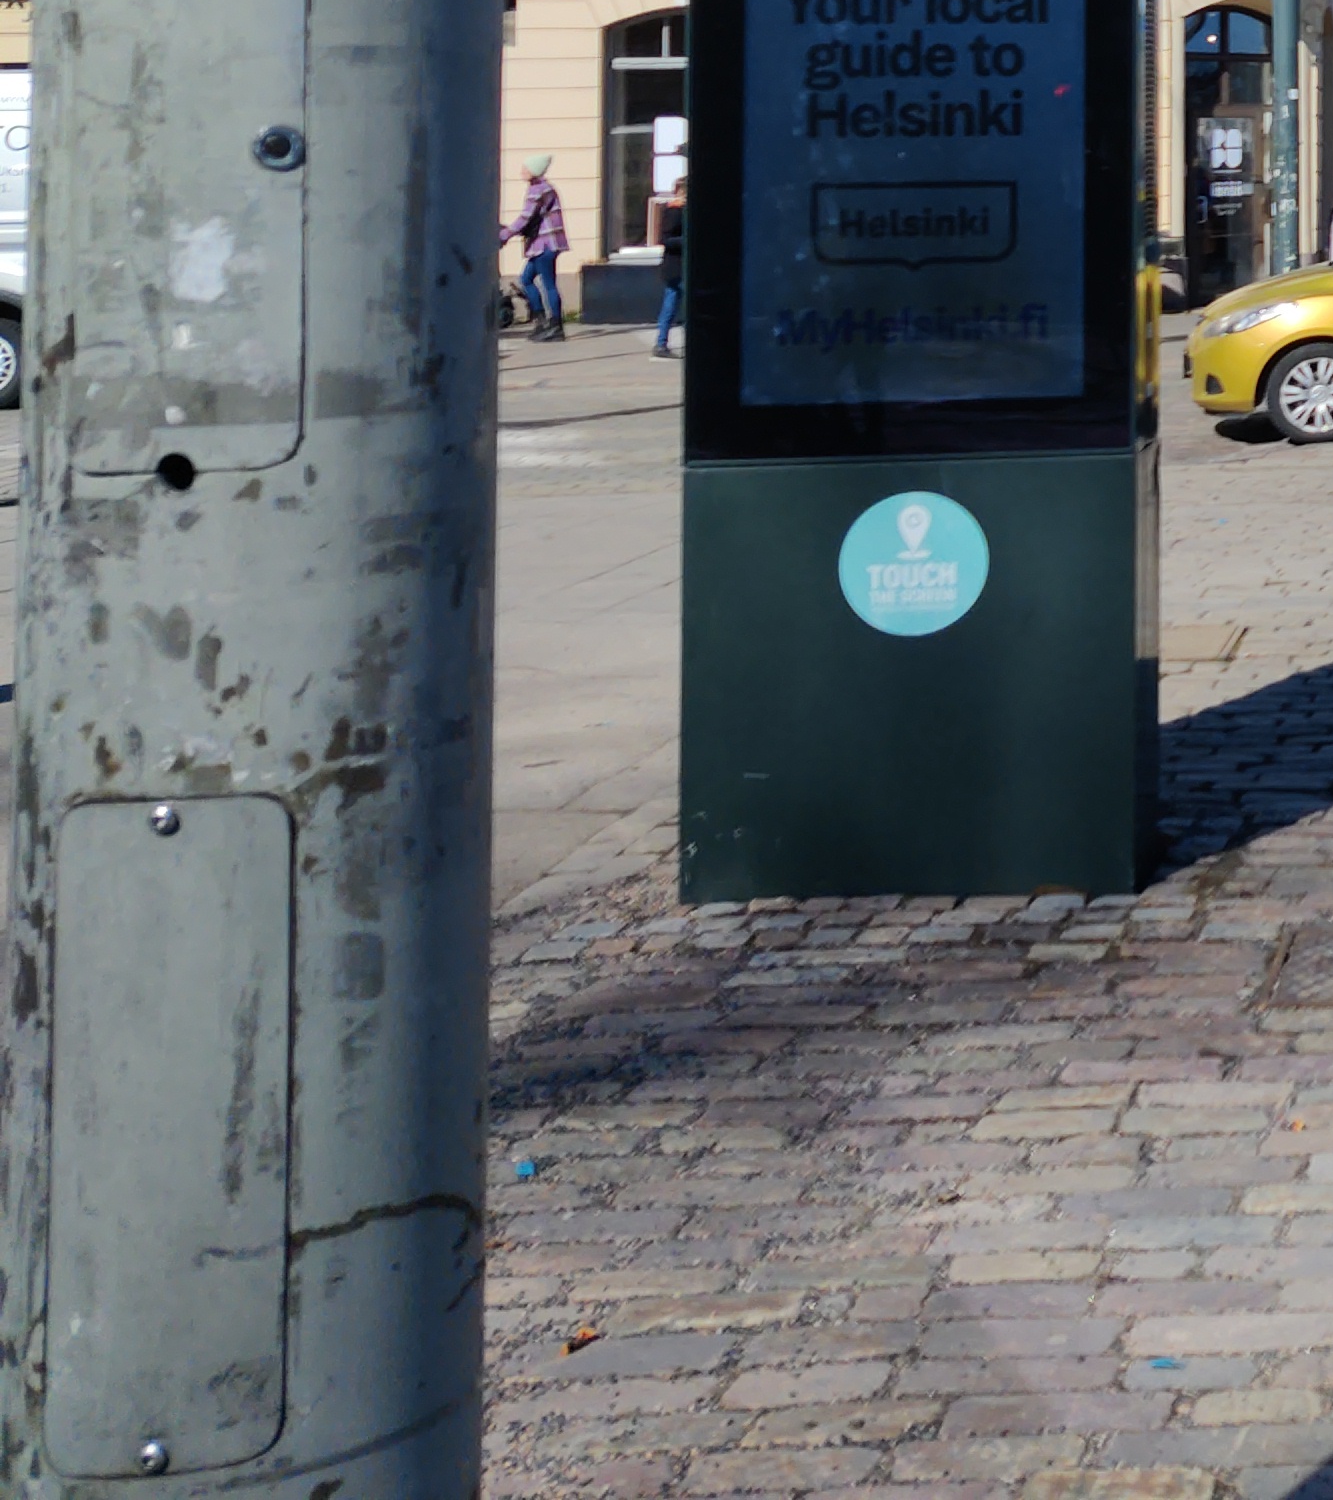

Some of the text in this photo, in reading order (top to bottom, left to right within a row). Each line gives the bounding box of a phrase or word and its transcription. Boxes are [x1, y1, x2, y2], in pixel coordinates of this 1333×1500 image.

[804, 32, 1023, 90] guide to
[806, 90, 1023, 138] Helsinki
[839, 205, 990, 239] Helsinki
[777, 306, 1048, 352] MyHelsinki.fi
[866, 562, 958, 589] TOUCH
